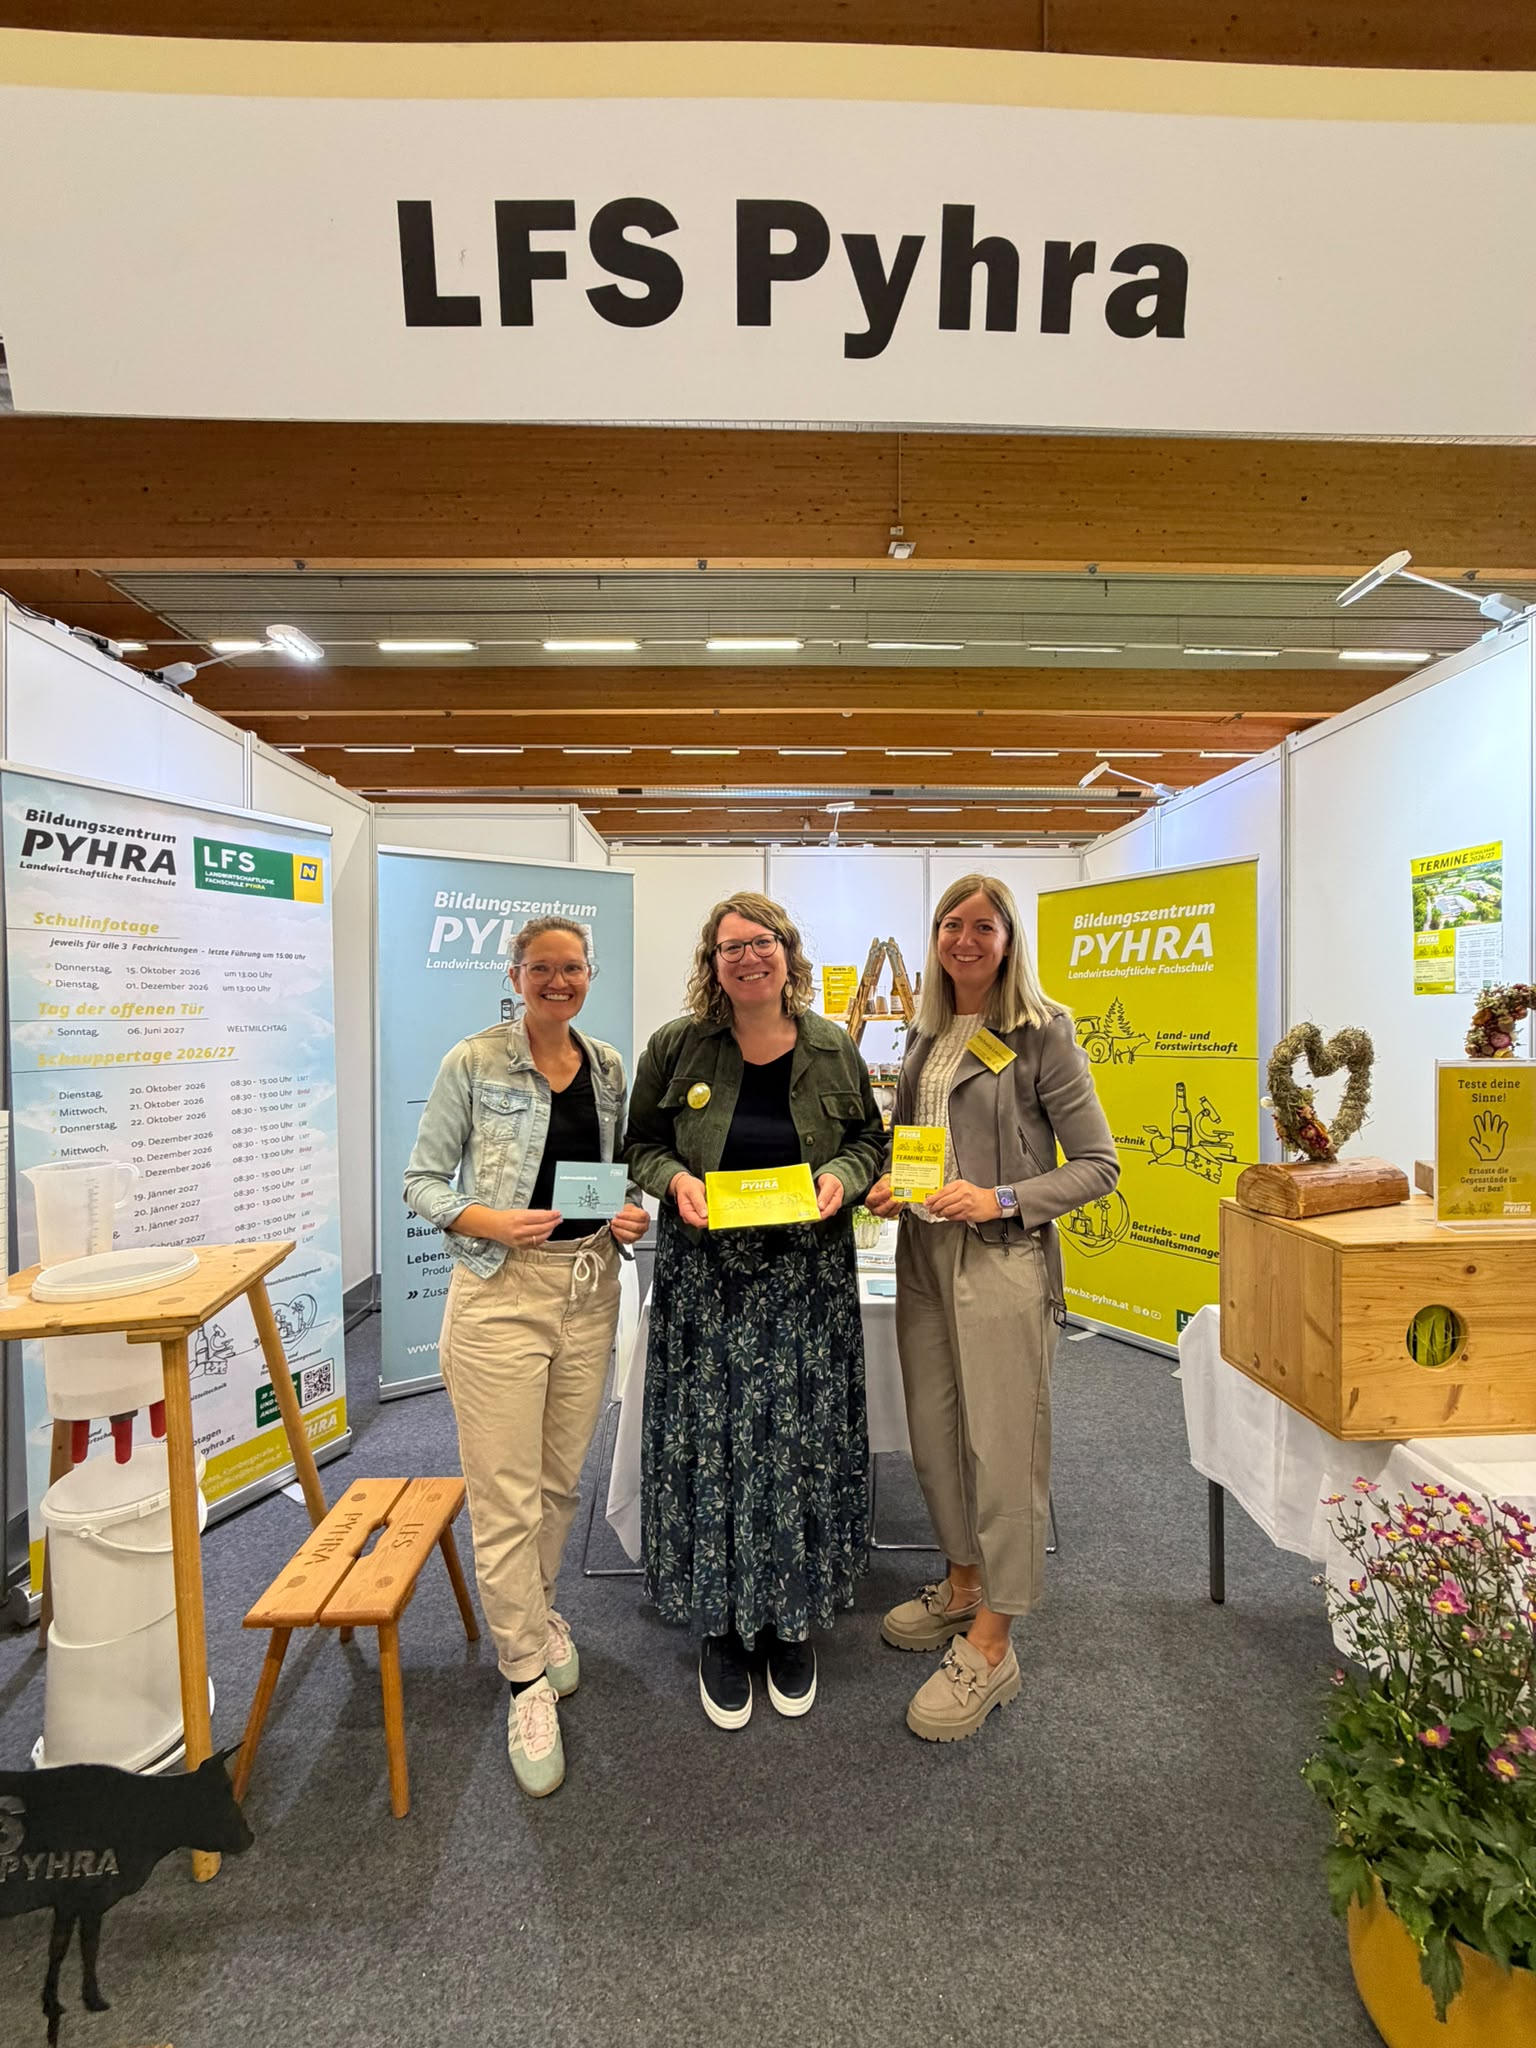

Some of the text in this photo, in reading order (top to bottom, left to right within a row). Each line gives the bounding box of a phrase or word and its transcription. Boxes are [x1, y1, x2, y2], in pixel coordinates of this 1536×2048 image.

[397, 197, 1189, 359] LFS Pyhra
[25, 809, 177, 844] Bildungszentrum
[21, 828, 177, 876] PYHRA
[204, 846, 256, 872] LFS
[1419, 853, 1469, 872] TERMINE
[19, 861, 177, 886] Landwirtschaftliche Fachschule
[205, 871, 275, 885] LANDWIRTSCHAFTLICHE
[205, 878, 244, 888] FACHSCHULE
[434, 891, 598, 917] Bildungszentrum
[33, 912, 160, 936] Schulinfotage
[1073, 902, 1216, 930] Bildungszentrum
[50, 938, 84, 948] jeweils
[86, 940, 100, 950] für
[102, 942, 120, 950] alle
[132, 943, 198, 954] Fachrichtungen
[208, 948, 230, 956] letzte
[230, 950, 261, 960] Führung
[1069, 922, 1214, 967] PYHRA
[54, 962, 112, 975] Donnerstag,
[126, 967, 138, 975] 15.
[140, 966, 176, 975] Oktober
[180, 968, 200, 976] 2026
[1068, 961, 1214, 980] Landwirtschaftliche Fachschule
[56, 979, 100, 991] Dienstag,
[140, 982, 185, 990] Dezember
[38, 1002, 204, 1018] Tag der offenen Tür
[58, 1024, 288, 1038] Sonntag, 06. Juni 2027 WELTMILCHTAG
[1156, 1030, 1210, 1040] Land- und
[37, 1046, 236, 1068] Schnuppertage 2026/27
[1154, 1041, 1238, 1053] Forstwirtschaft
[58, 1090, 104, 1100] Dienstag,
[130, 1088, 144, 1096] 20.
[146, 1084, 182, 1094] Oktober
[184, 1082, 206, 1091] 2026
[1458, 1079, 1520, 1089] Teste deine
[59, 1106, 108, 1118] Mittwoch,
[130, 1103, 142, 1111] 21.
[144, 1100, 180, 1110] Oktober
[184, 1098, 204, 1106] 2026
[1472, 1093, 1507, 1103] Sinne!
[60, 1122, 118, 1134] Donnerstag,
[130, 1118, 144, 1126] 22.
[146, 1114, 183, 1125] Oktober
[186, 1112, 207, 1120] 2026
[60, 1144, 109, 1157] Mittwoch,
[131, 1140, 146, 1148] 09.
[148, 1134, 192, 1147] Dezember
[193, 1131, 214, 1140] 2026
[132, 1156, 146, 1164] 10.
[146, 1149, 192, 1162] Dezember
[192, 1146, 213, 1155] 2026
[280, 1135, 294, 1143] Uhr
[144, 1164, 190, 1178] Dezember
[190, 1161, 212, 1171] 2026
[280, 1148, 294, 1157] Uhr
[134, 1194, 146, 1202] 19.
[146, 1188, 176, 1200] Jänner
[177, 1184, 199, 1194] 2027
[282, 1166, 295, 1175] Uhr
[1460, 1176, 1508, 1184] Gegenstände
[134, 1210, 148, 1218] 20.
[150, 1202, 178, 1214] Jänner
[180, 1200, 200, 1208] 2027
[282, 1180, 296, 1189] Uhr
[134, 1226, 147, 1234] 21.
[148, 1218, 178, 1232] Jänner
[178, 1214, 200, 1224] 2027
[282, 1194, 296, 1203] Uhr
[186, 1234, 206, 1244] 2027
[283, 1213, 296, 1222] Uhr
[283, 1226, 296, 1236] Uhr
[1132, 1220, 1201, 1243] Betriebs- und
[1130, 1231, 1220, 1259] Haushaltsmanage
[408, 1252, 452, 1265] Lebens
[422, 1287, 448, 1299] Zusa
[304, 1512, 363, 1566] PYHRA
[392, 1523, 424, 1549] LFS
[0, 1848, 120, 1882] PYHRA
